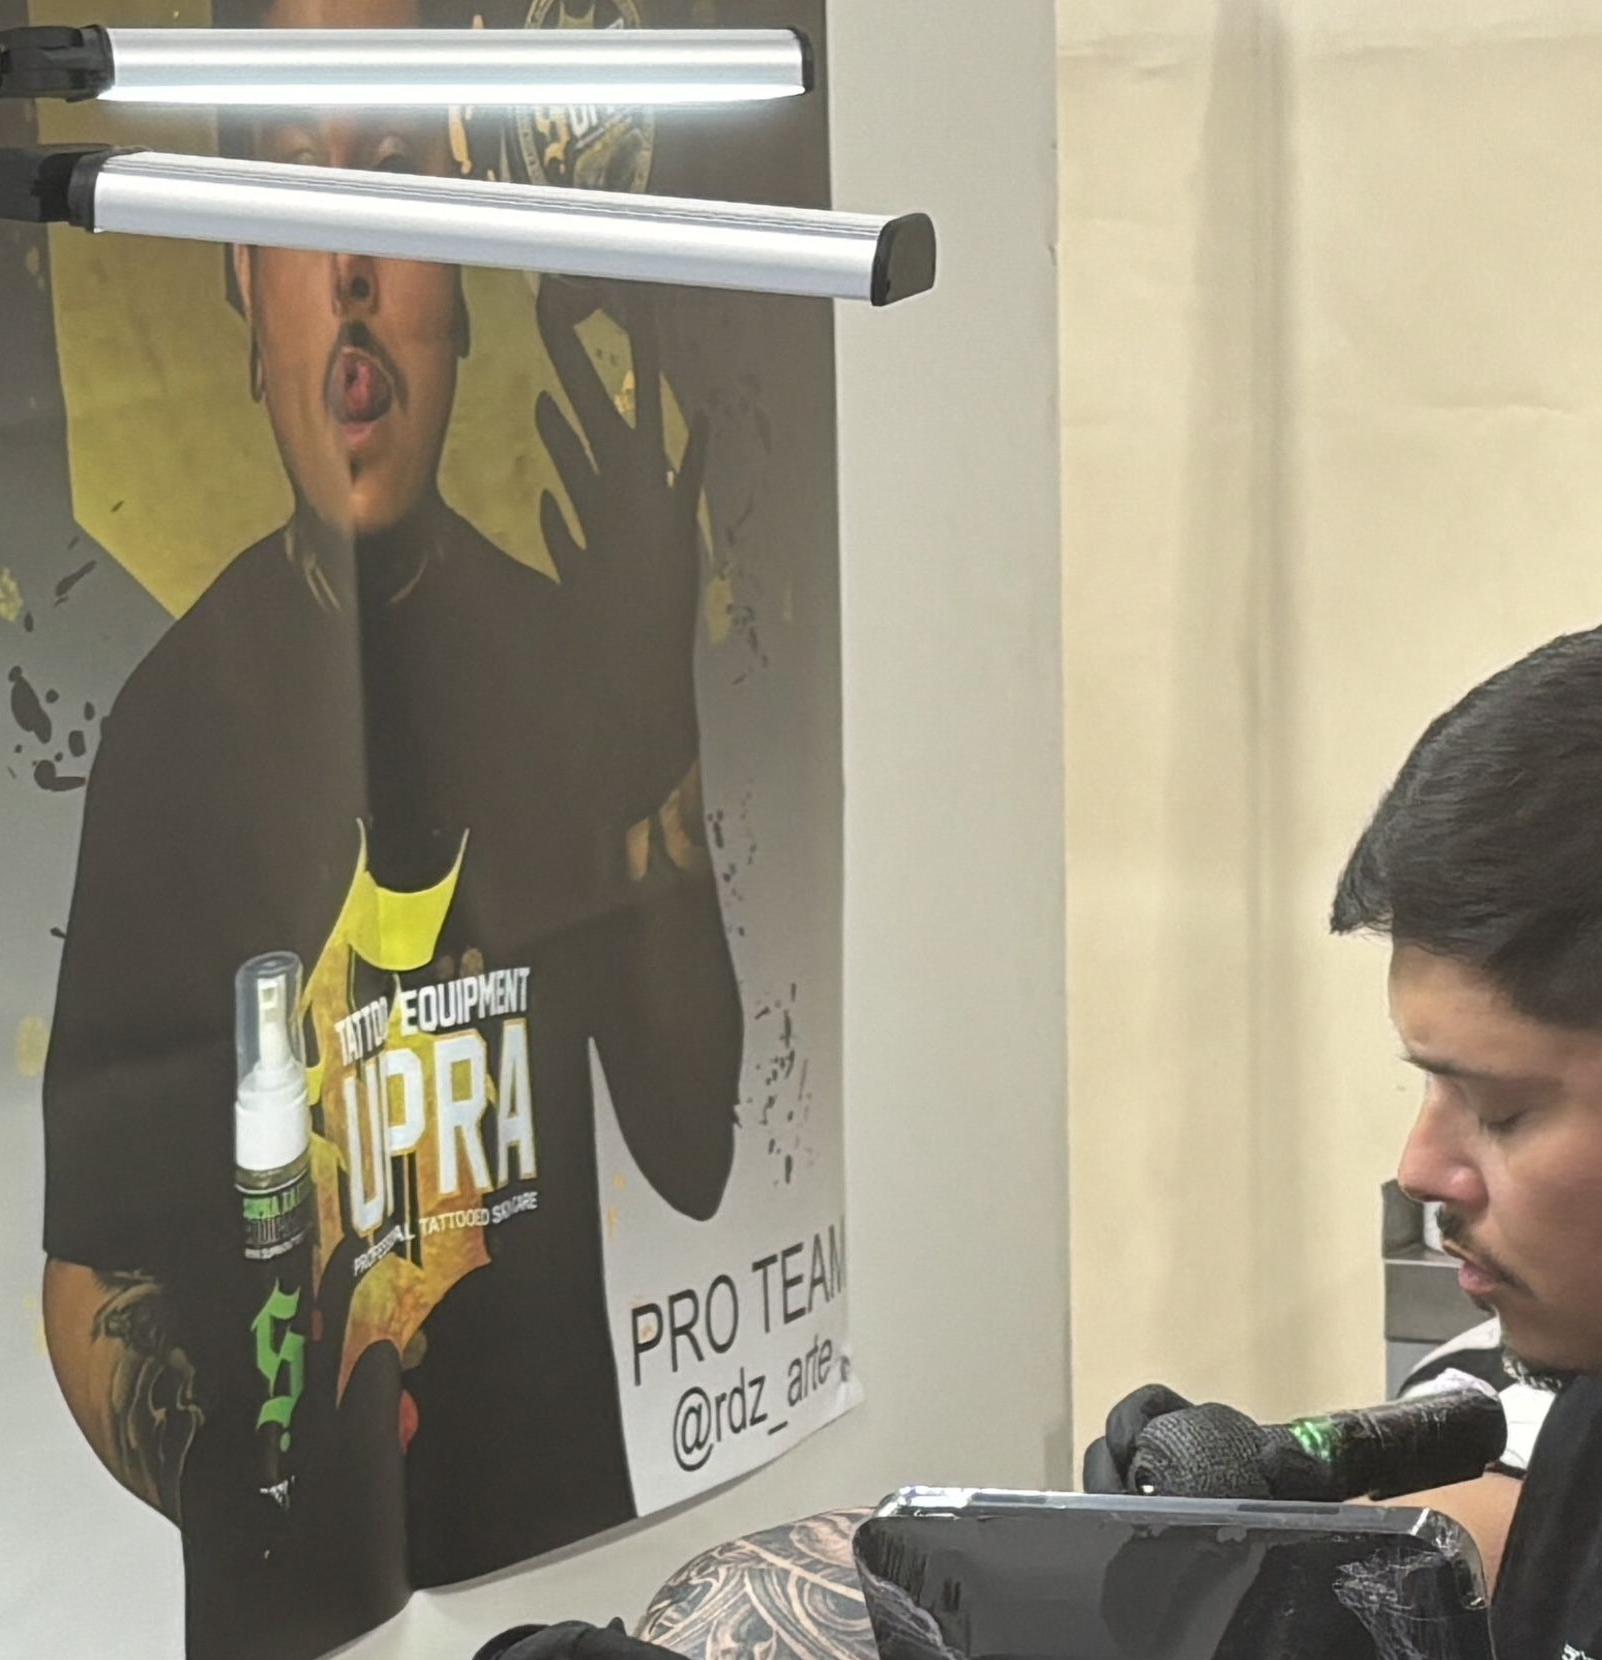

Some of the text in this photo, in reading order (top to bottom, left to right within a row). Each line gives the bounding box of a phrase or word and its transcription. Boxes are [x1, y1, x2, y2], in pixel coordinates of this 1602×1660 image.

[399, 967, 530, 1036] EQUIPMENT
[419, 1208, 490, 1235] TATTOOED
[631, 1214, 846, 1387] PRO TEAM
